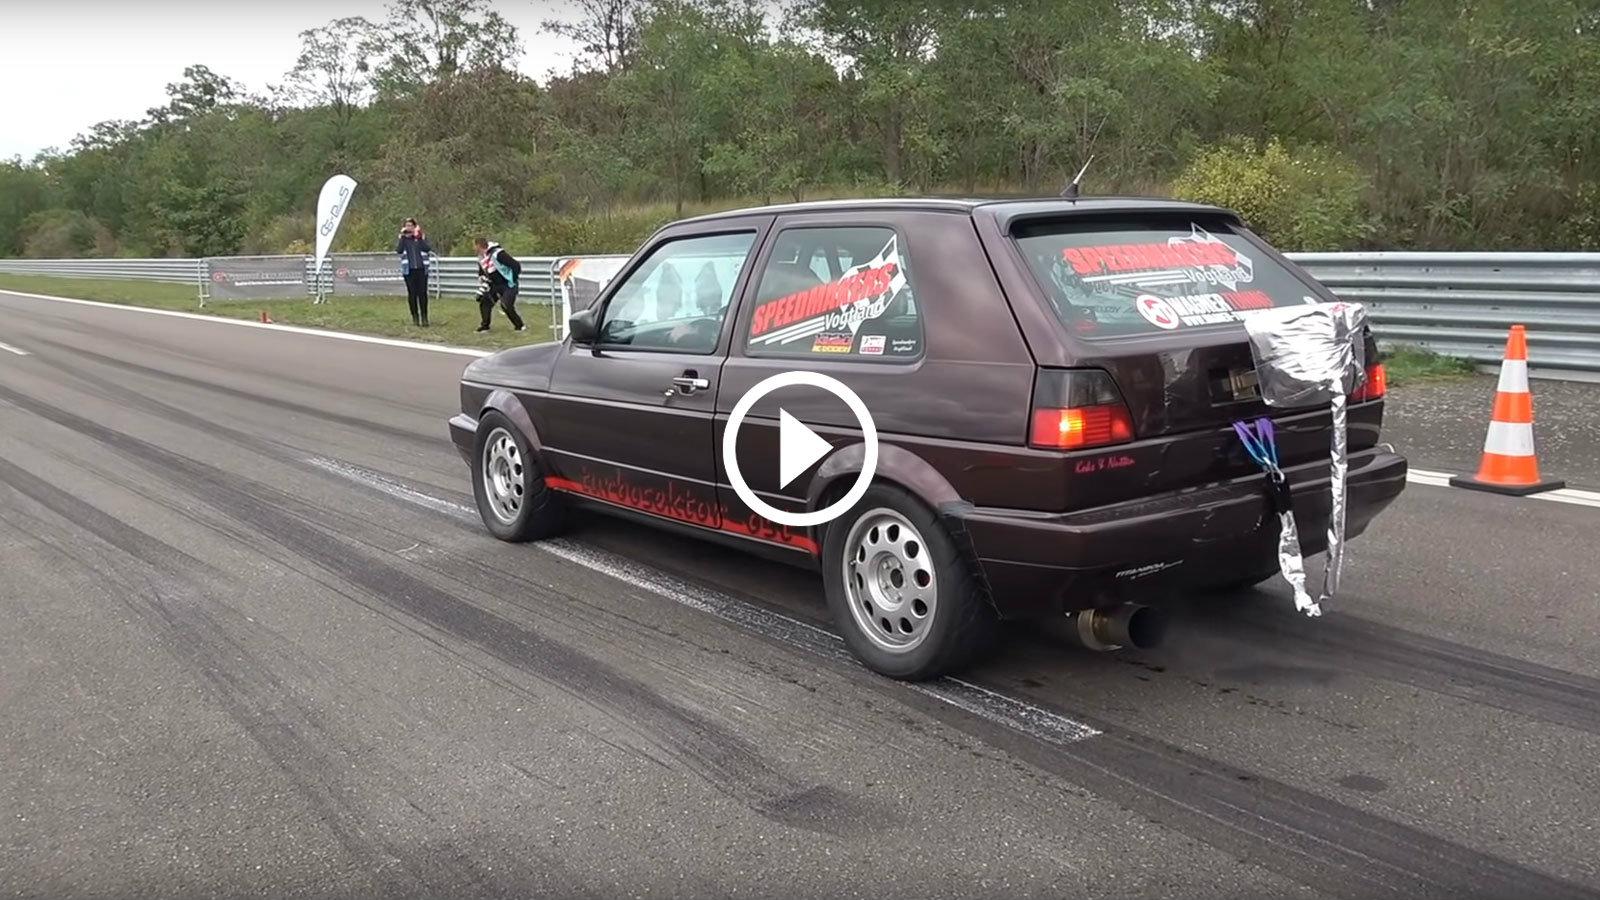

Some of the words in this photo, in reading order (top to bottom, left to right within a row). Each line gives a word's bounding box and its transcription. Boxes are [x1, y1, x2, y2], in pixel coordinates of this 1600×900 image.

[1063, 242, 1238, 276] SPEEDMAKERS
[1184, 266, 1250, 286] Vogtland
[751, 262, 899, 336] SPEEDMAKERS
[824, 295, 886, 331] Vogtland
[1163, 293, 1233, 316] WAGNER
